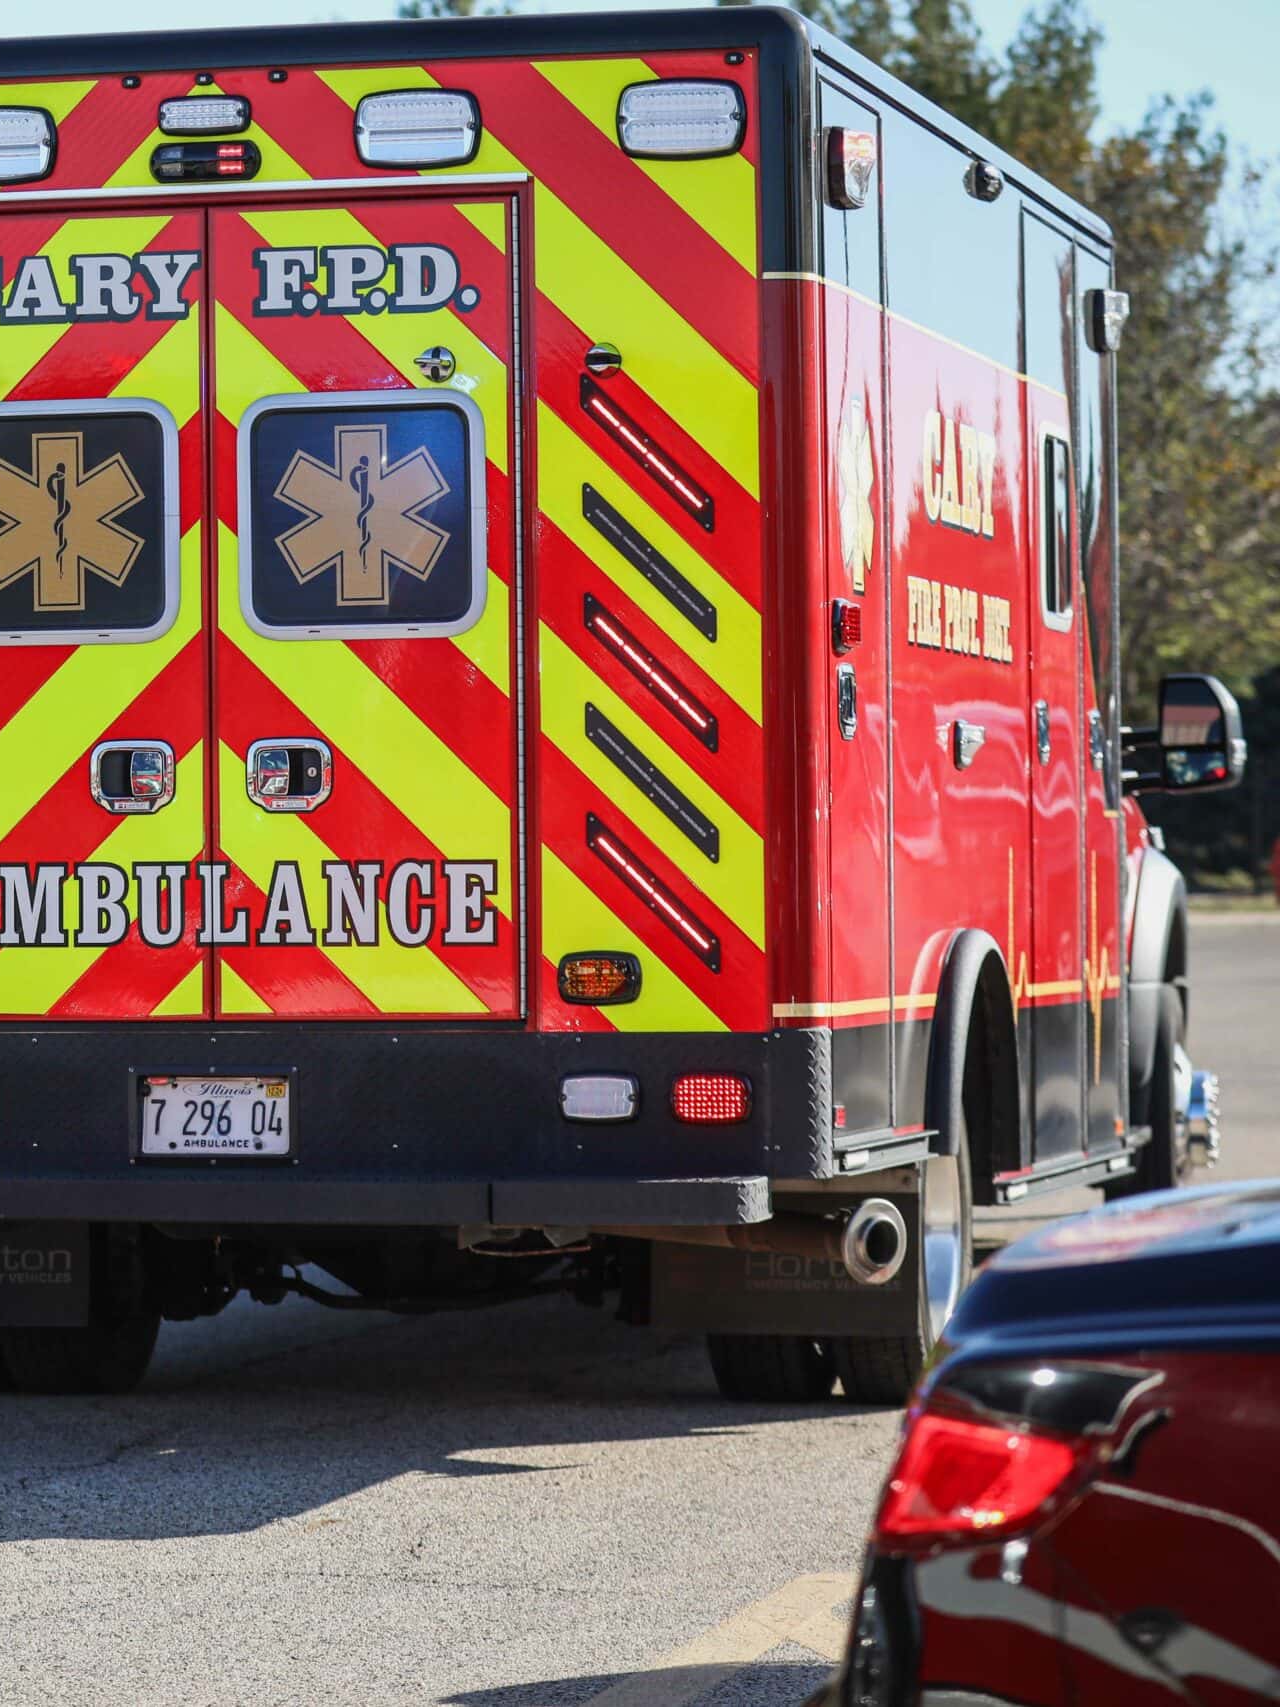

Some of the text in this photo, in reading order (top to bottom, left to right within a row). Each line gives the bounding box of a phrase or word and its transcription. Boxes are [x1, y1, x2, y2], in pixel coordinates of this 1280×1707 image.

[252, 244, 481, 317] F.P.D.
[923, 408, 996, 540] CARY
[907, 575, 942, 648] FIRE
[192, 1081, 253, 1096] Illinois
[151, 1099, 283, 1136] 7 296 04
[183, 1139, 249, 1148] AMBULANCE
[8, 1272, 72, 1284] VEHICLES
